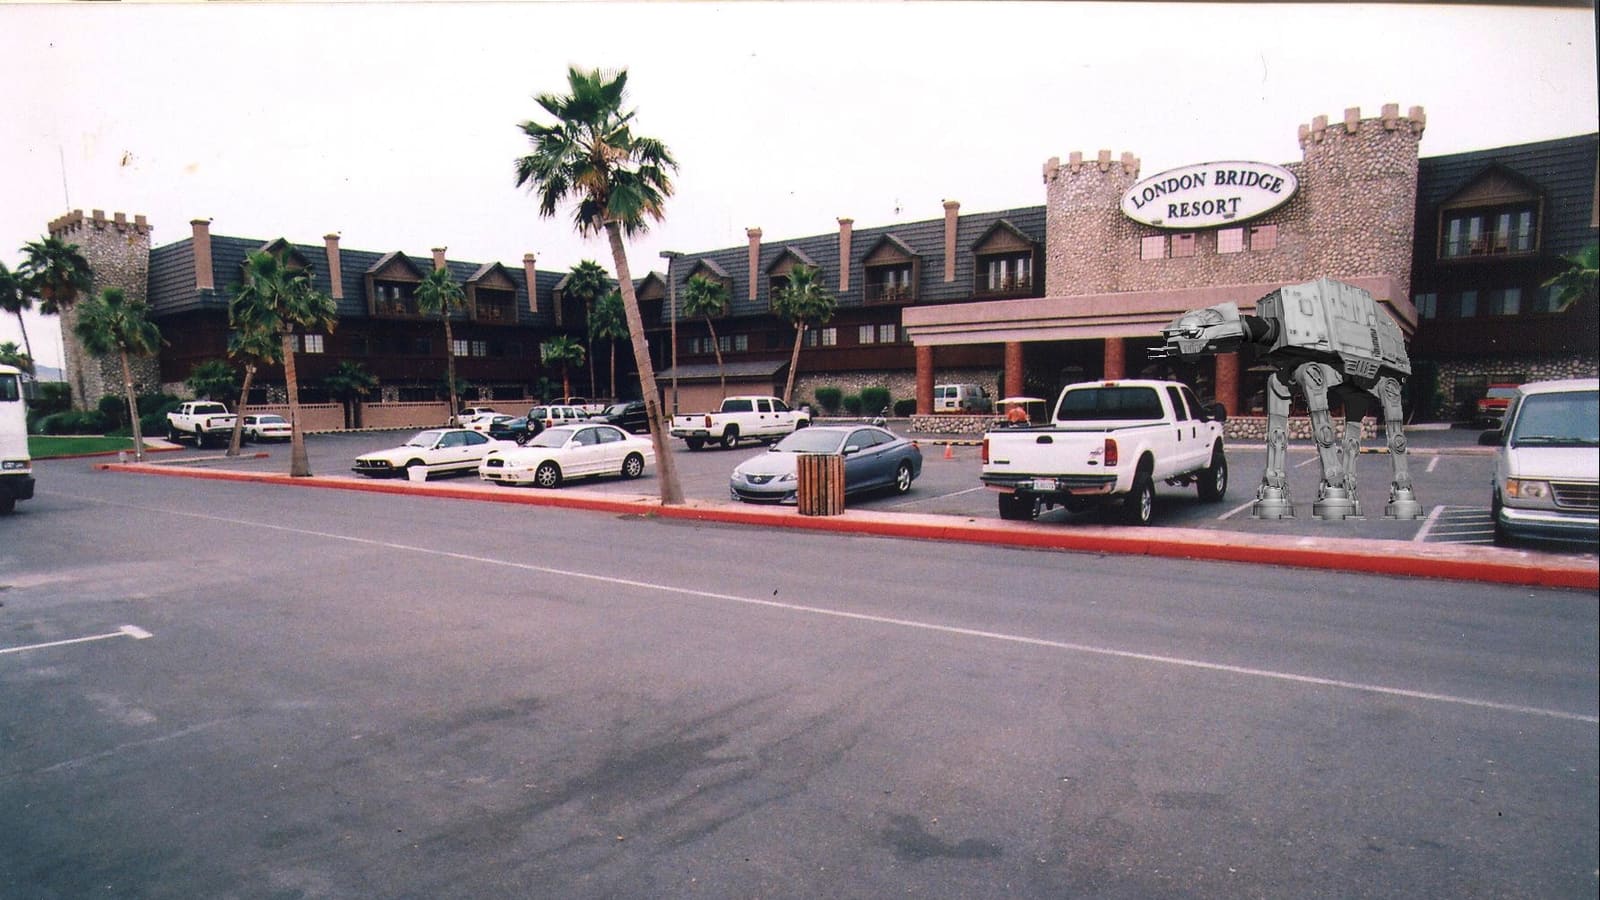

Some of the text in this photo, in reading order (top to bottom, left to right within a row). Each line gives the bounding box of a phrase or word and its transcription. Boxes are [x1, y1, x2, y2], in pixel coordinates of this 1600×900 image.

[1131, 170, 1284, 209] LONDON BRIDGE
[1167, 197, 1241, 218] RESORT
